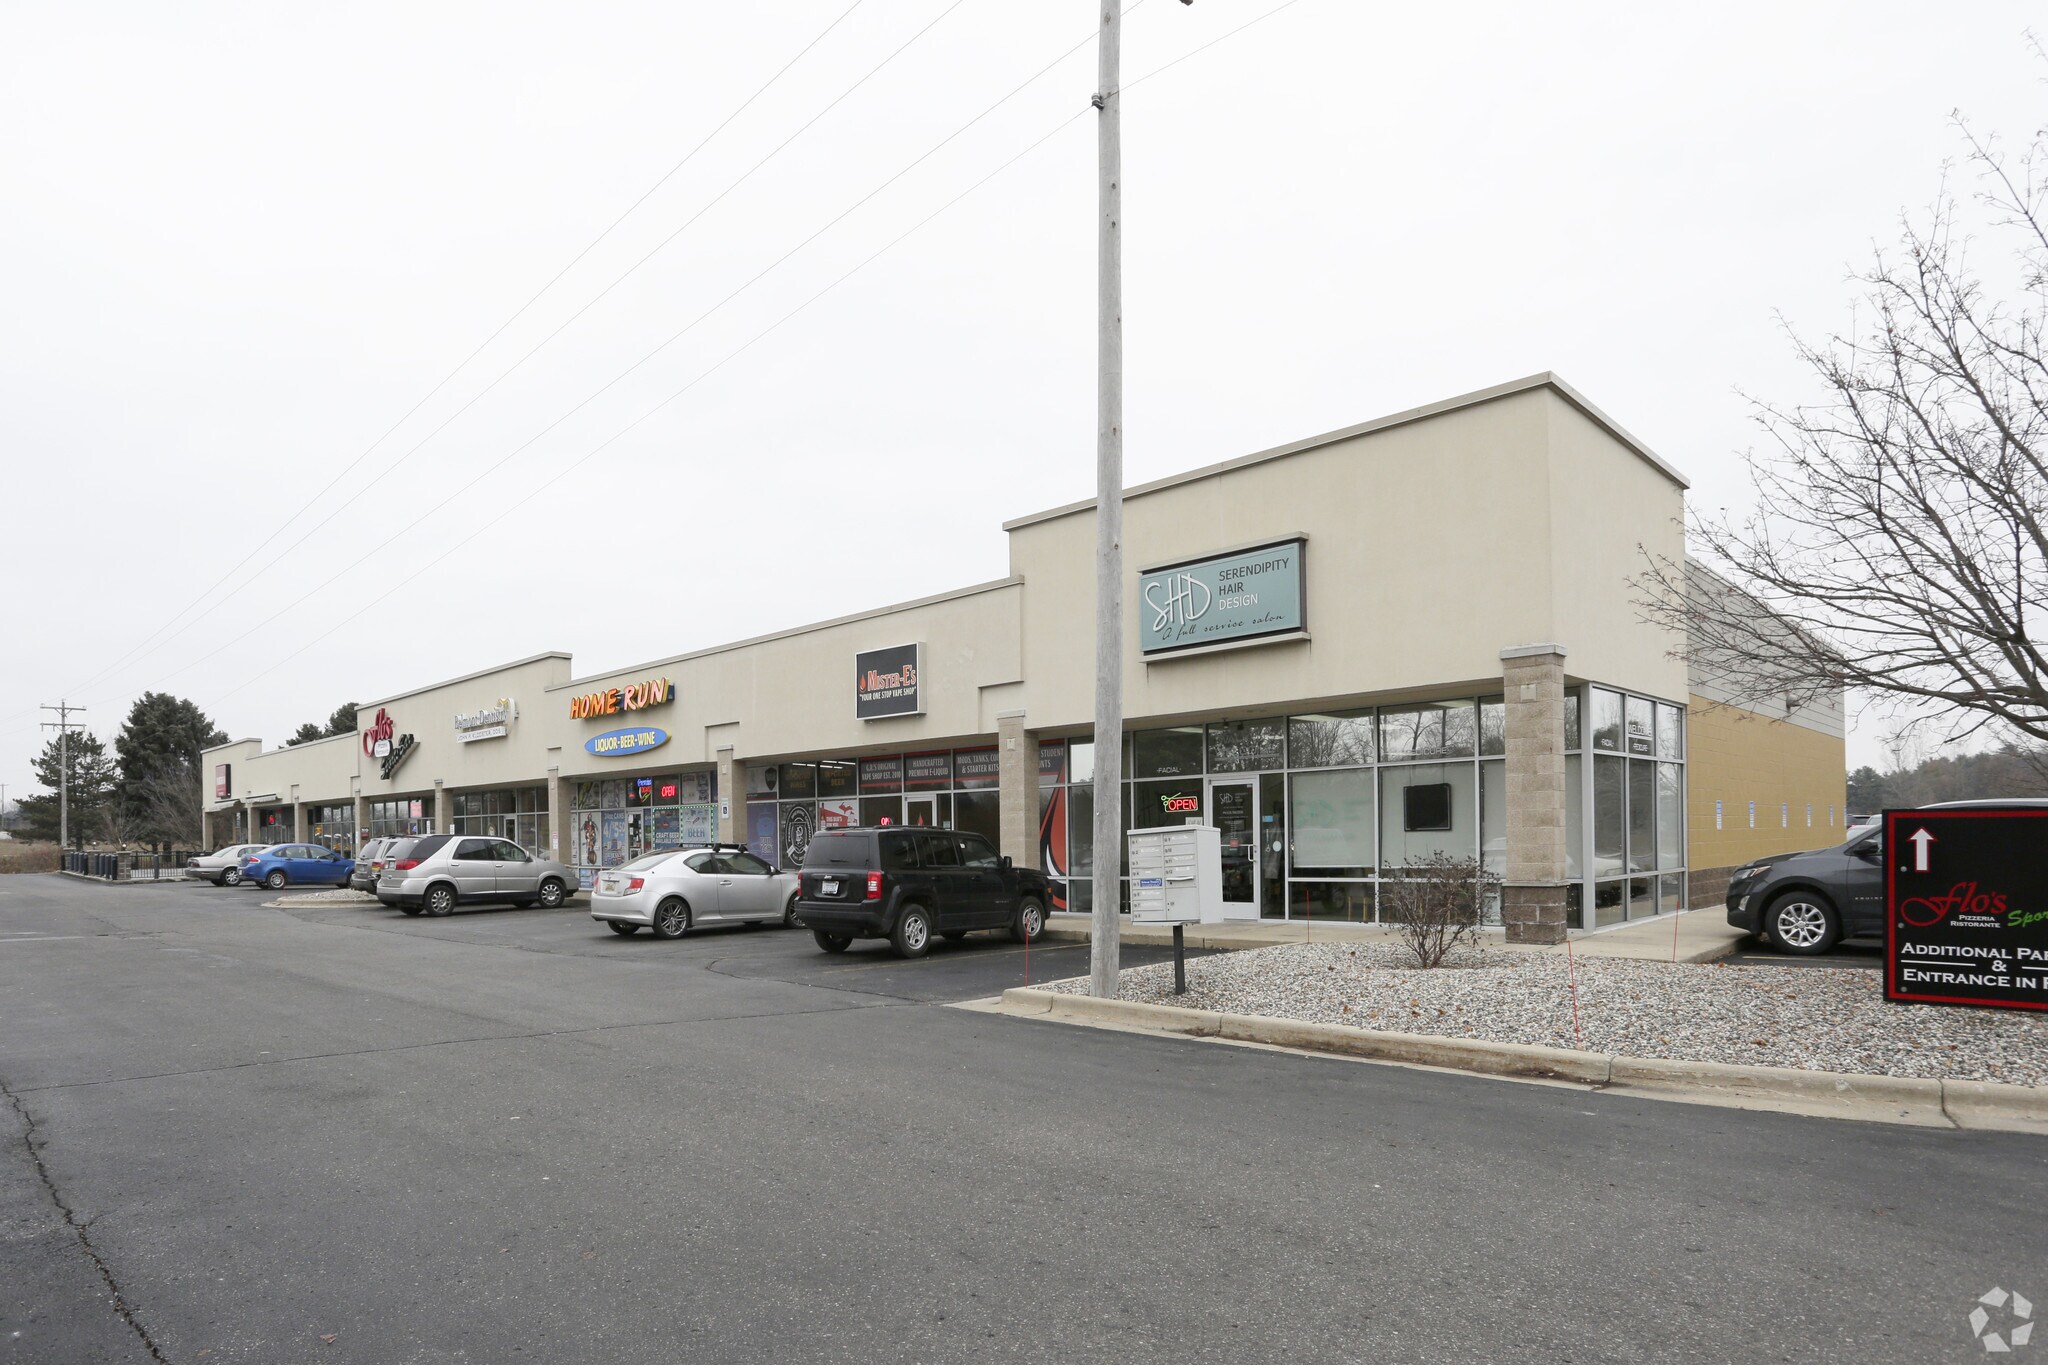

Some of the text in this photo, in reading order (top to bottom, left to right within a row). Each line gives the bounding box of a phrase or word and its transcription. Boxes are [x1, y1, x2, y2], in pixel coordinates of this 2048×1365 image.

[1218, 557, 1290, 582] SERENDIPITY
[1218, 581, 1245, 596] HAIR
[1145, 572, 1212, 633] SHD
[1218, 593, 1258, 611] DESIGN
[1176, 624, 1197, 642] full
[1204, 619, 1245, 633] service
[1252, 611, 1286, 625] salon
[570, 677, 669, 720] HOME RUN
[872, 692, 882, 700] ONE
[881, 691, 892, 699] STOP
[892, 689, 903, 697] VAPE
[1040, 748, 1064, 758] STUDENT
[912, 758, 944, 767] HANDCRAFTED
[966, 764, 988, 773] STARTER
[987, 763, 1000, 772] KITS
[871, 772, 883, 780] SHOP
[908, 767, 949, 777] PREMIUM E-LIQUID
[661, 785, 677, 797] OPEN
[1168, 799, 1197, 811] OPEN
[1950, 920, 2001, 928] RISTORANTE
[1958, 914, 1995, 922] PIZZERIA
[1901, 942, 2013, 960] ADDITIONAL
[1991, 960, 2007, 972] &
[1903, 968, 2011, 988] ENTRANCE
[2015, 976, 2037, 989] IN
